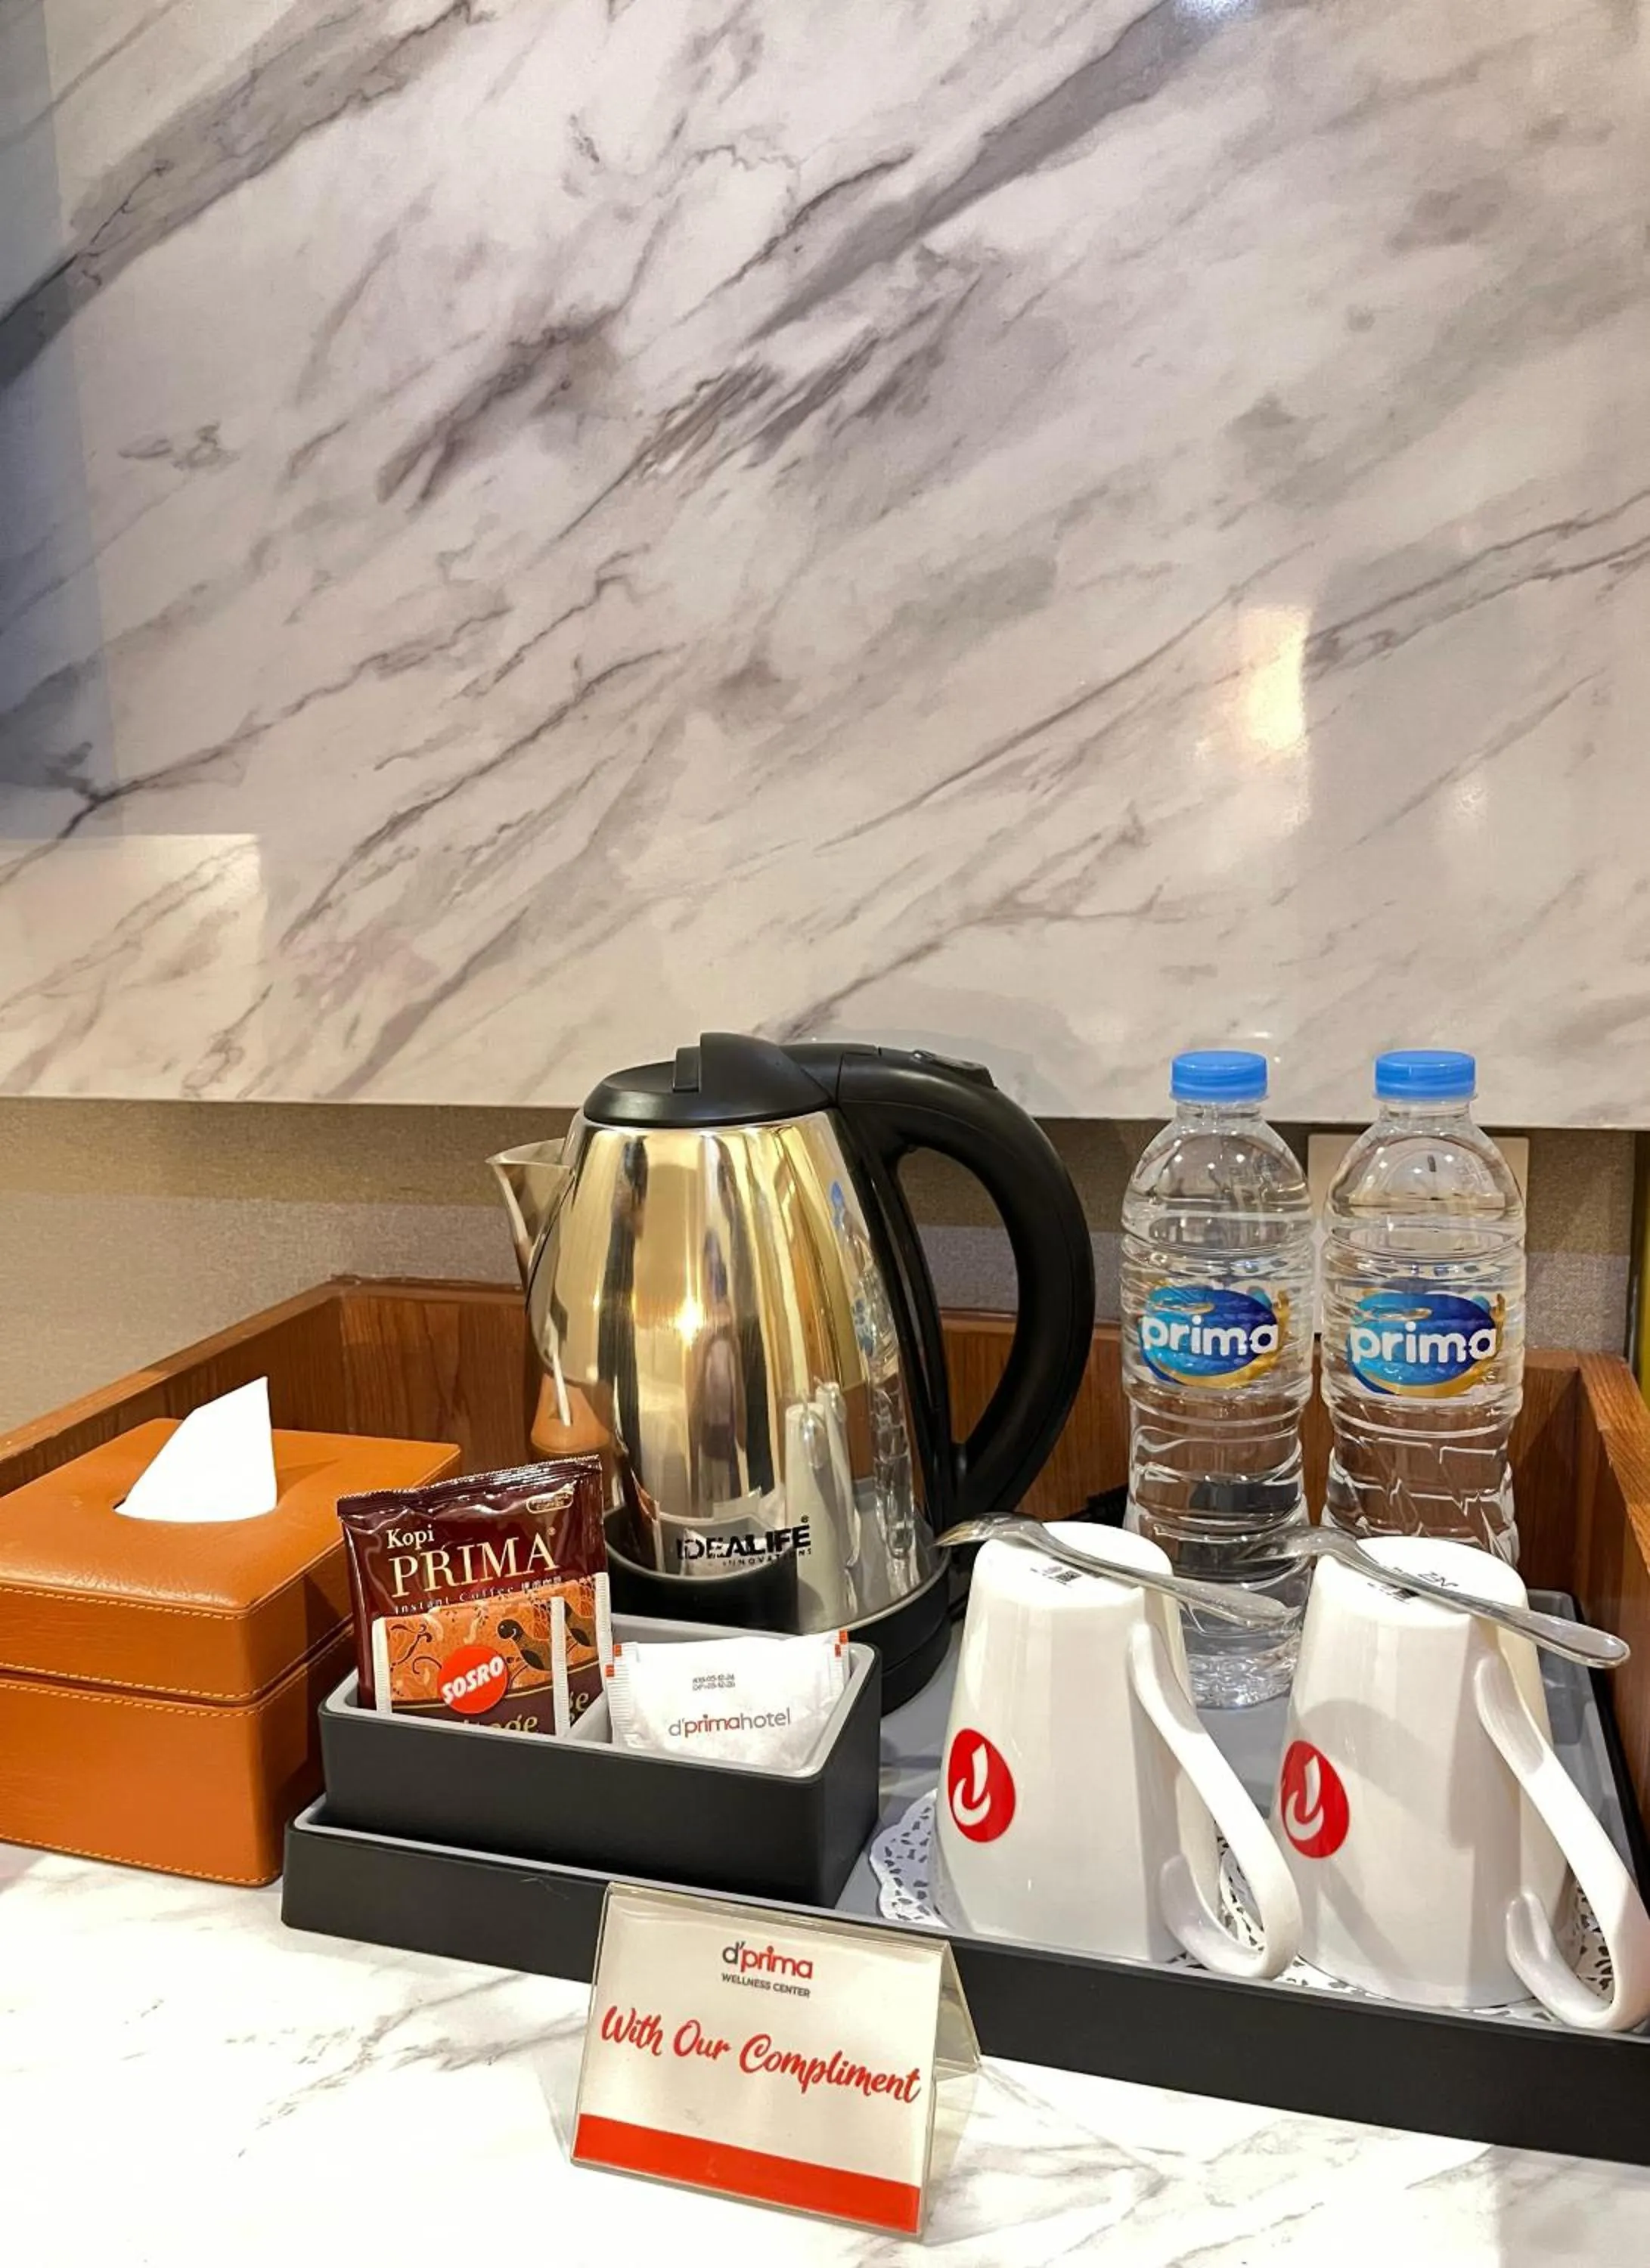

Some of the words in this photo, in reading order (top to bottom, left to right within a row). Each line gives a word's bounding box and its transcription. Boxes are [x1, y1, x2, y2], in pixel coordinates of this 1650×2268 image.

[1140, 1315, 1279, 1358] prima
[1350, 1322, 1496, 1364] prima
[386, 1525, 435, 1549] Kopi
[677, 1525, 811, 1560] IDEALIFE
[389, 1532, 560, 1598] PRIMA
[441, 1656, 505, 1704] SOSRO
[722, 1941, 813, 1979] d'prima
[721, 1972, 771, 1991] WELLNESS
[773, 1982, 811, 1998] CENTER
[601, 2005, 663, 2056] With
[673, 2019, 732, 2059] Our
[739, 2033, 921, 2103] Compliment
